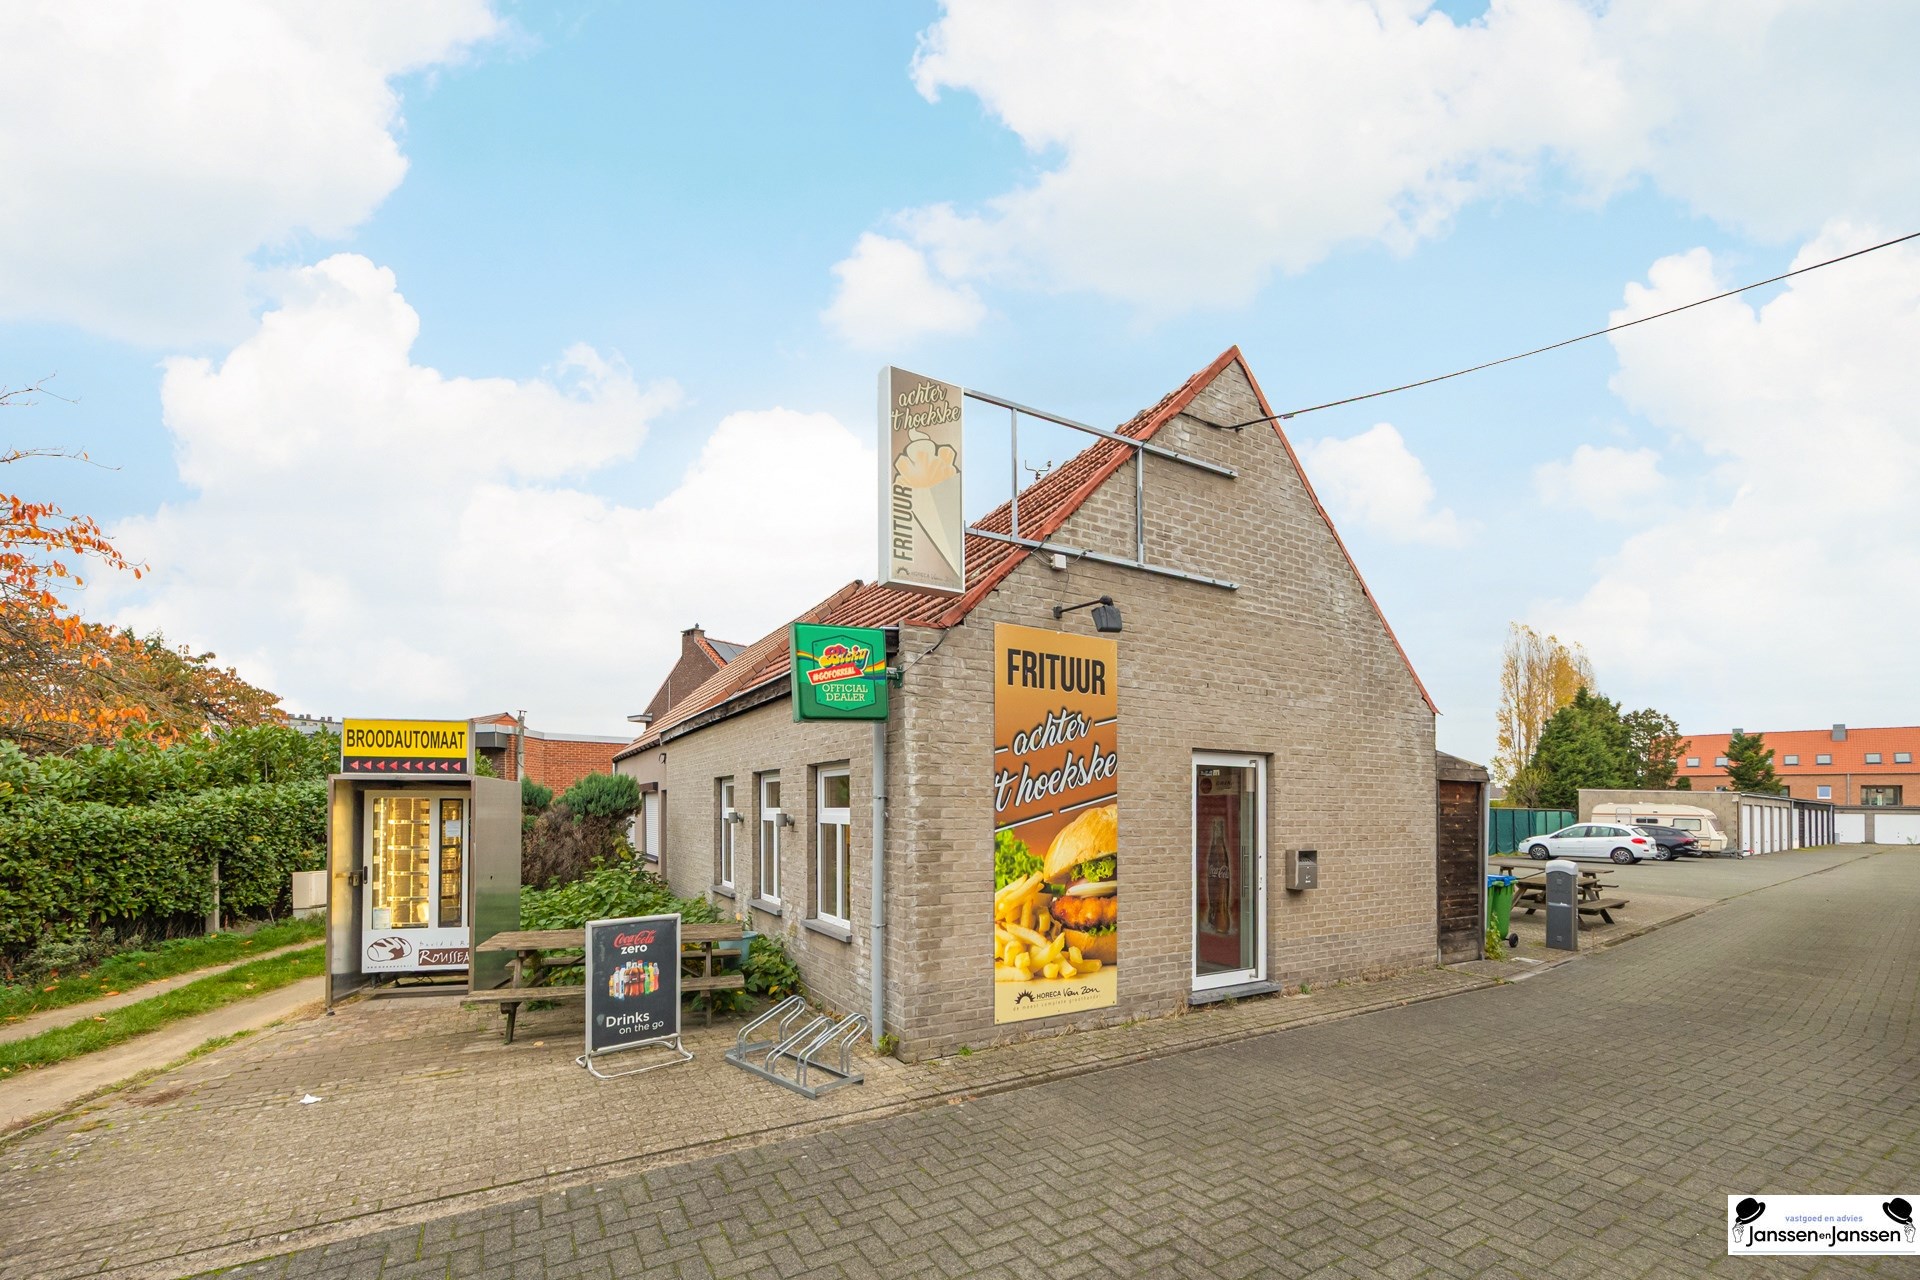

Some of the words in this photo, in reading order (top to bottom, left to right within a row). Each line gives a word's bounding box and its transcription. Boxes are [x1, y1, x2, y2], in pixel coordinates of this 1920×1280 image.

[898, 381, 948, 407] achter
[903, 401, 961, 430] hoekske
[893, 484, 913, 561] FRITUUR
[812, 666, 856, 681] #GOFORREAL
[1007, 648, 1106, 696] FRITUUR
[822, 683, 868, 693] OFFICIAL
[825, 692, 865, 702] DEALER
[346, 729, 465, 749] BROODAUTOMAAT
[1013, 708, 1091, 756] achter
[1015, 744, 1117, 807] hoekske
[613, 930, 657, 948] Coca-Cola
[620, 944, 648, 955] zero
[1036, 990, 1061, 999] HORECA
[1063, 987, 1079, 997] Van
[1080, 985, 1100, 995] Zon
[606, 1012, 650, 1028] Drinks
[619, 1027, 632, 1035] on
[634, 1023, 650, 1032] the
[652, 1020, 664, 1030] go
